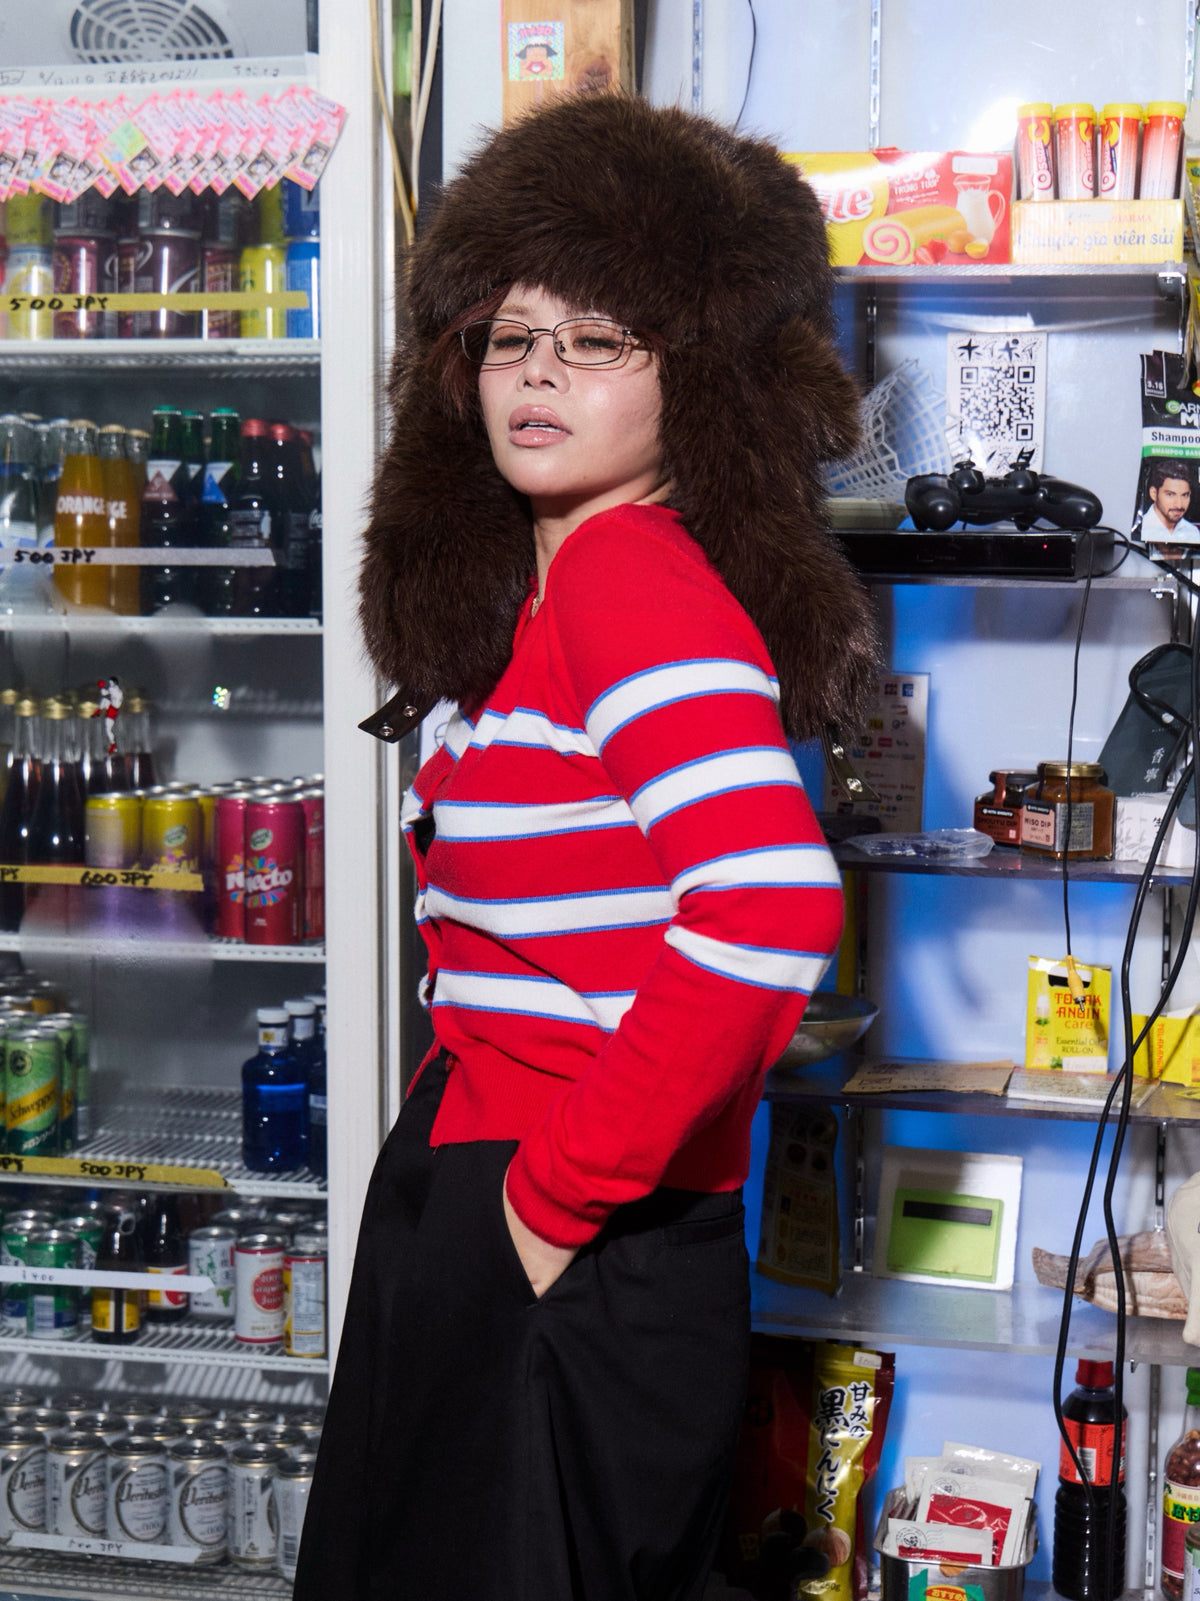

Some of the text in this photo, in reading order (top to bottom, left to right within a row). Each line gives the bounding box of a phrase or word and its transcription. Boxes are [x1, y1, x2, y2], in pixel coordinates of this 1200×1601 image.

[1083, 231, 1109, 252] gia
[1113, 230, 1146, 246] viên
[1150, 228, 1175, 246] sủi
[10, 296, 108, 311] 500 JPY
[1181, 411, 1200, 427] M
[1151, 431, 1200, 445] Shampoo
[1151, 448, 1184, 456] SHAMPOO
[56, 495, 104, 515] ORANGE
[14, 549, 95, 564] 500 JPY
[1024, 818, 1051, 828] MISO DIP
[80, 871, 153, 885] 600 JPY
[1054, 992, 1102, 1006] TOAK
[1056, 1006, 1100, 1020] ANGIN
[1065, 1020, 1093, 1029] care
[1056, 1037, 1087, 1045] Essential
[1062, 1045, 1093, 1054] ROLL-ON
[80, 1162, 147, 1180] 500 JPY
[849, 1381, 872, 1439] 甘みの
[813, 1387, 850, 1522] 黒にんにく
